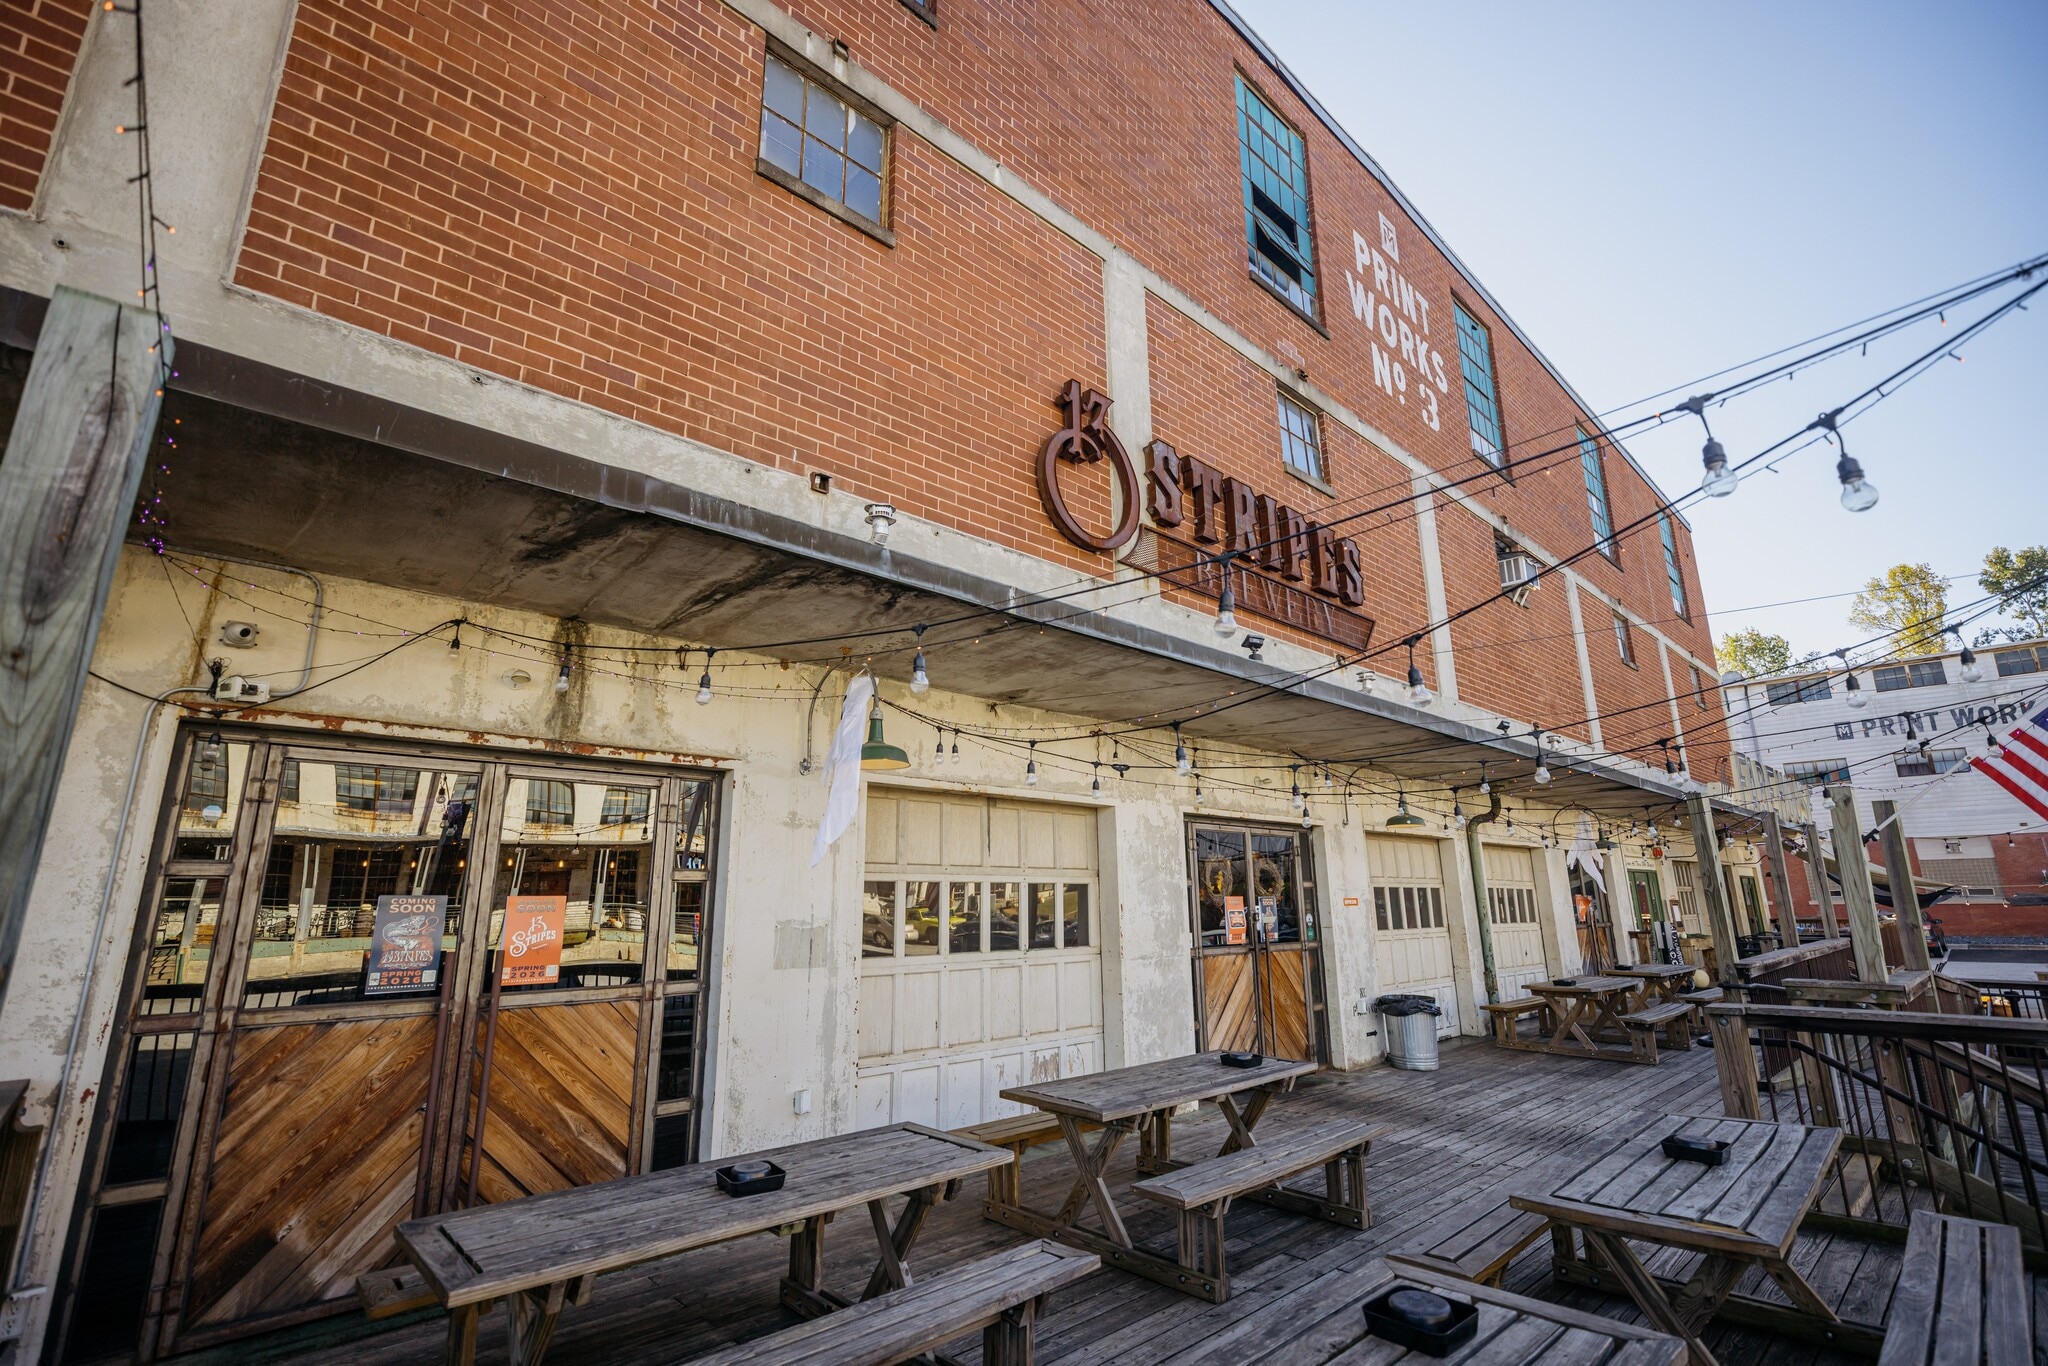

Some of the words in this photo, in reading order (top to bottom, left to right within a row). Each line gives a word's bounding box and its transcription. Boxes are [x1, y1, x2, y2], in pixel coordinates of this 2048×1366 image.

[1352, 229, 1429, 336] PRINT
[1345, 270, 1448, 394] WORKS
[1419, 383, 1440, 432] 3
[1144, 438, 1365, 607] STRIPES
[1196, 550, 1338, 635] BREWERY
[1862, 711, 1939, 738] PRINT
[389, 904, 436, 913] SOON
[516, 904, 556, 913] SOON
[509, 930, 557, 957] STRIPES
[380, 976, 421, 986] 2026
[381, 970, 421, 978] SPRING
[510, 970, 545, 979] 2026
[511, 964, 546, 972] SPRING
